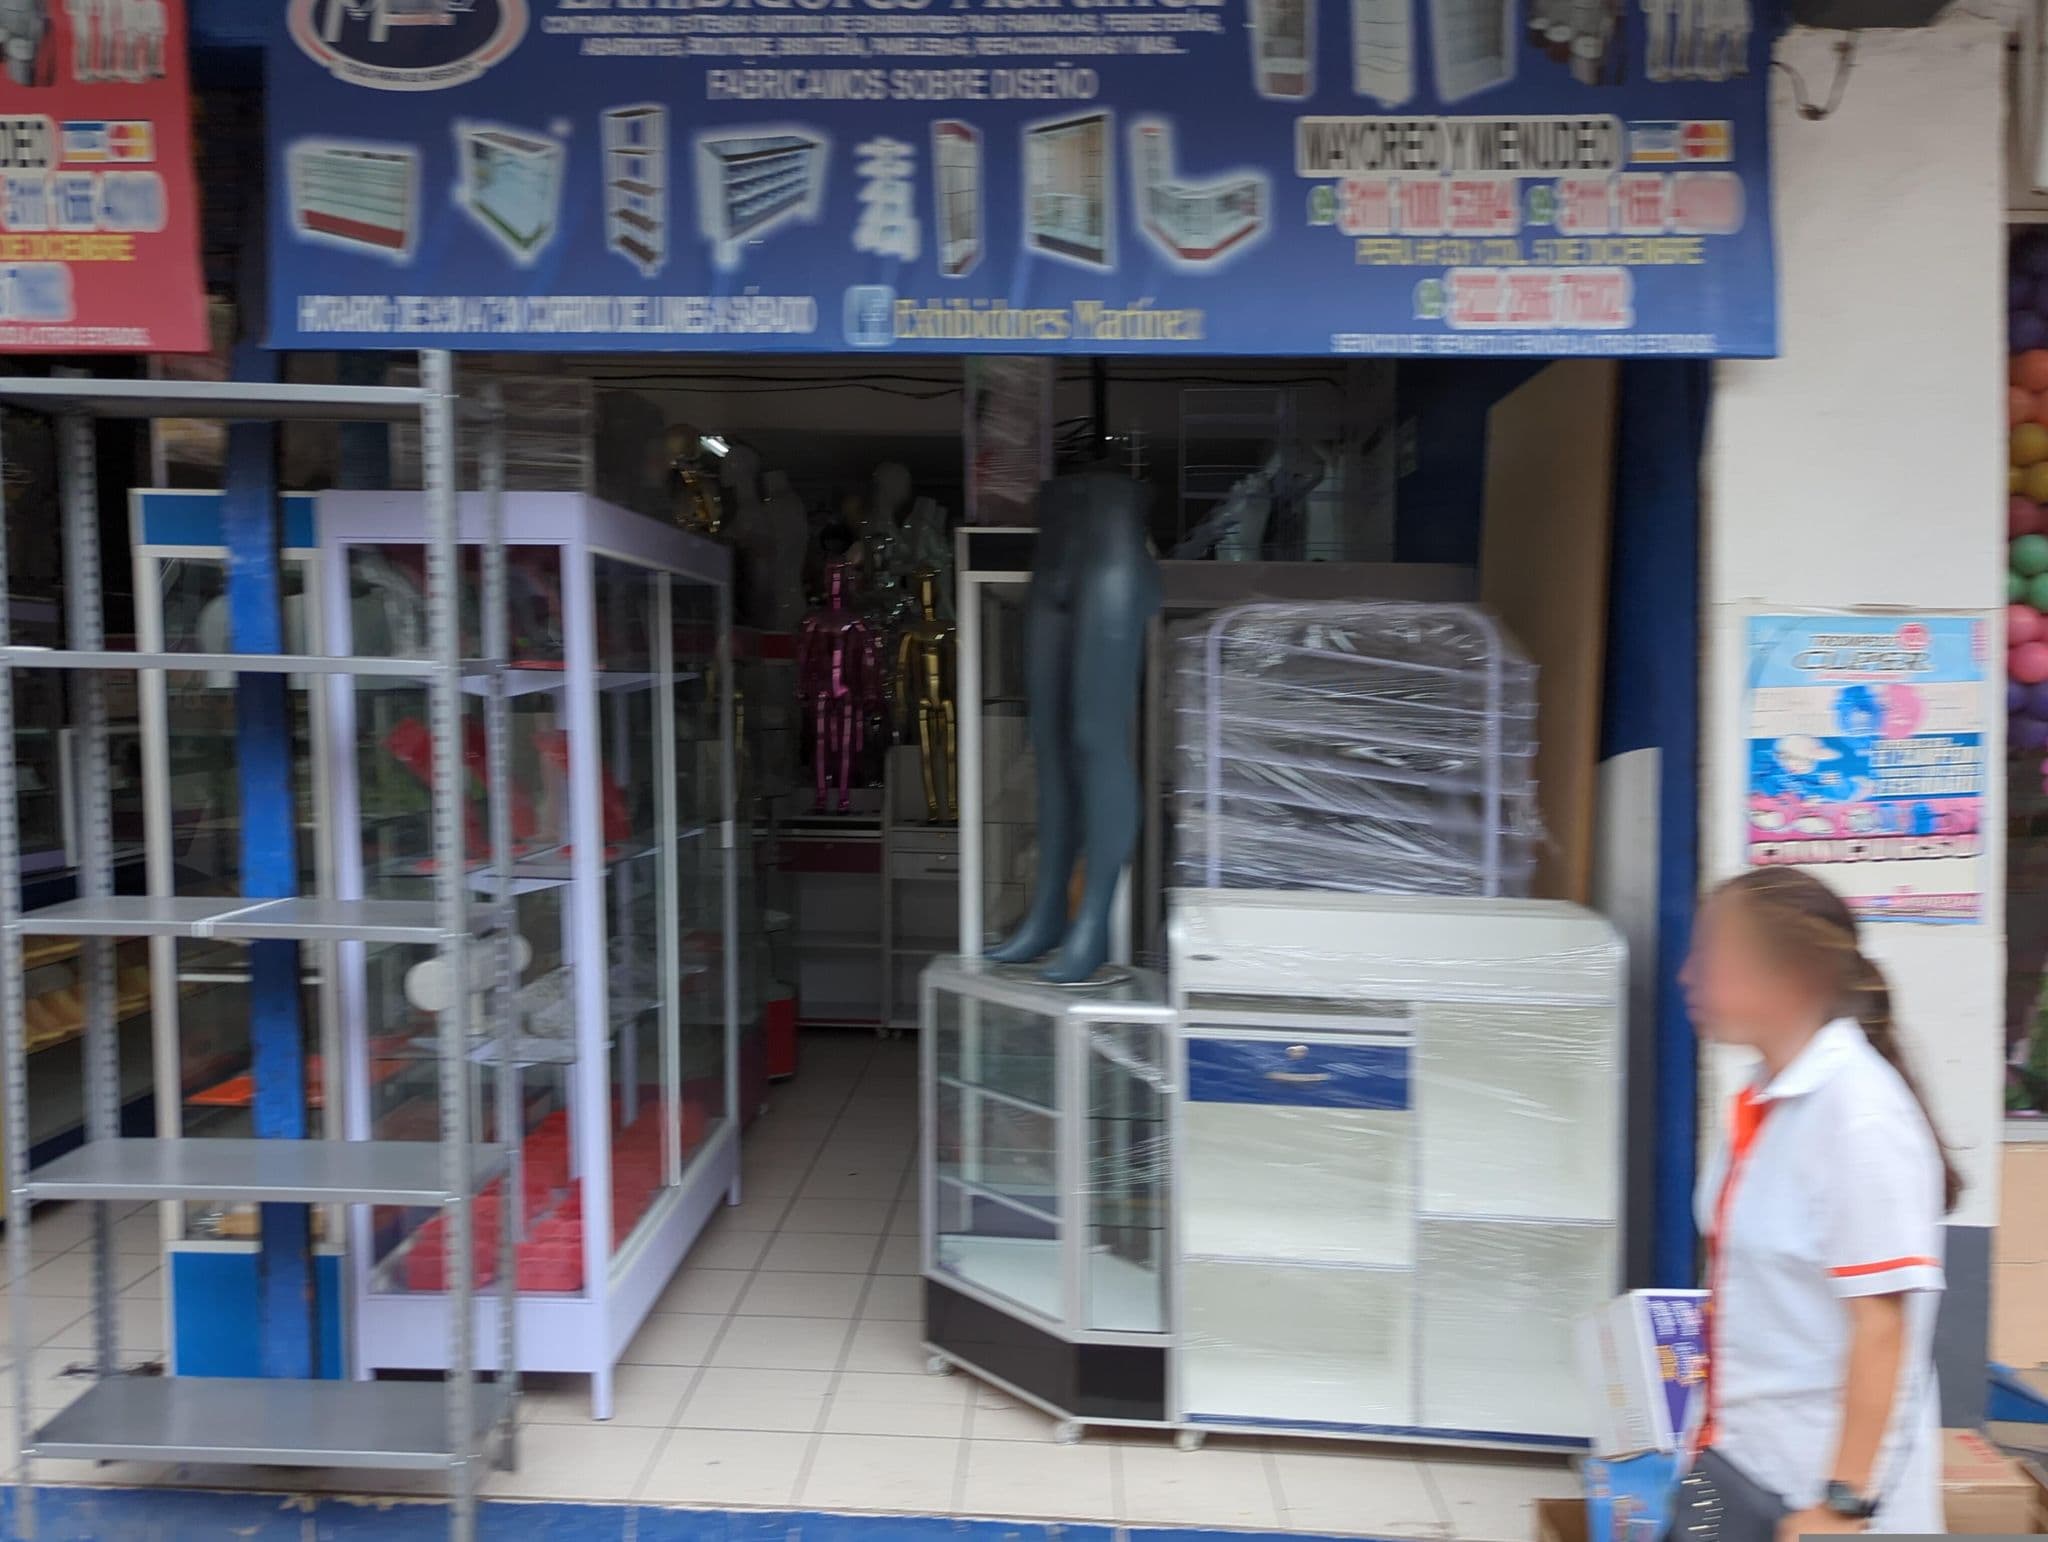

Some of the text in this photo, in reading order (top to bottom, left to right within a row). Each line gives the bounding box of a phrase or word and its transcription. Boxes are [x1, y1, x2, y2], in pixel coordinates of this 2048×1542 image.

[706, 61, 1099, 99] FABRICAMOS SOBRE DISEÑO
[1304, 122, 1444, 169] MAYOREO
[1446, 122, 1474, 169] Y
[1475, 121, 1619, 169] MENUDEO
[1553, 238, 1583, 263] DE
[1586, 237, 1705, 264] DICIEMBRE
[398, 296, 428, 332] DE
[618, 296, 648, 333] DE
[649, 296, 712, 333] LUNES
[894, 297, 1206, 340] Exhibidores Martínez
